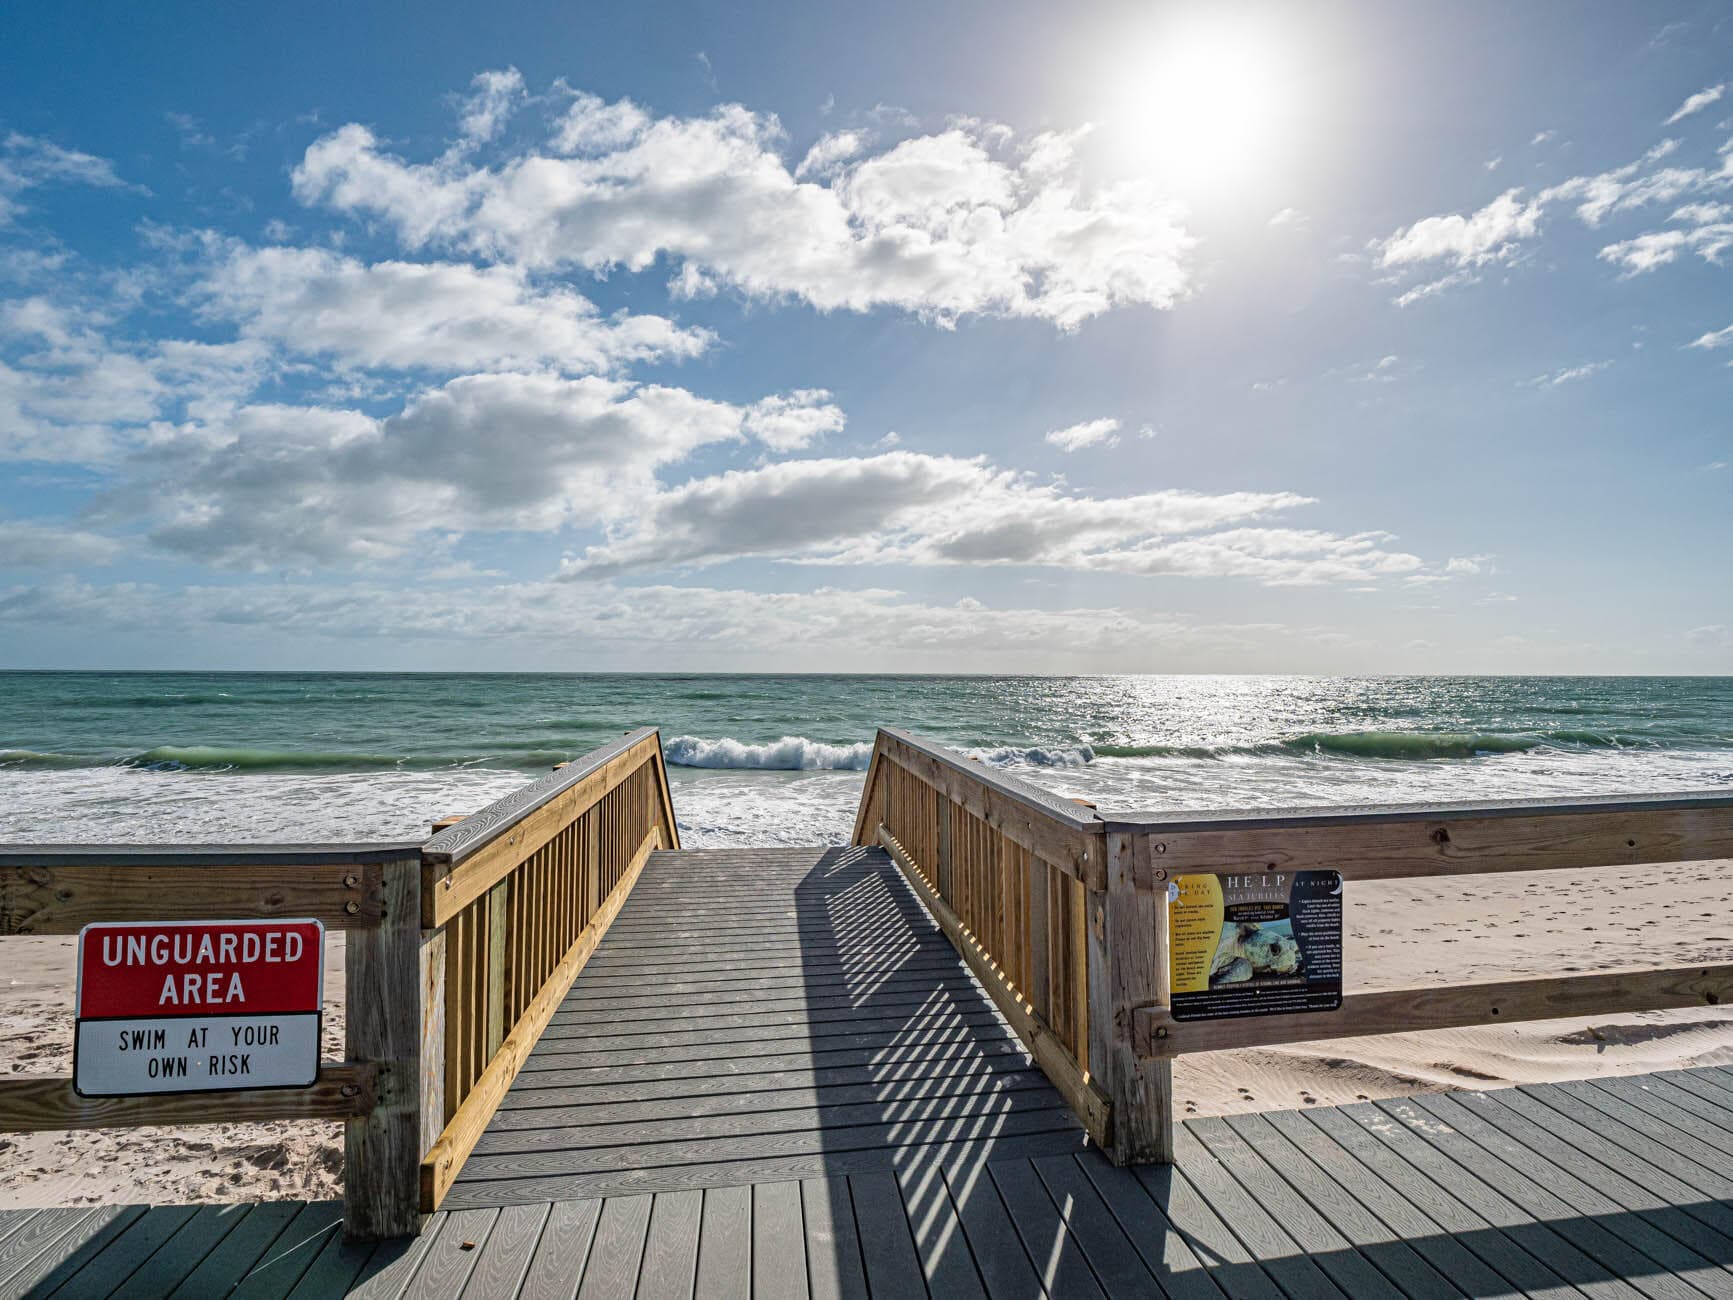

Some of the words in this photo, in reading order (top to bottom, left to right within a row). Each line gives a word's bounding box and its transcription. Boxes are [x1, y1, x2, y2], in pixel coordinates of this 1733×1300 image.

[1227, 874, 1285, 889] HELP
[102, 932, 303, 967] UNGUARDED
[158, 972, 246, 1005] AREA
[118, 1029, 166, 1051] SWIM
[187, 1027, 209, 1048] AT
[231, 1025, 279, 1046] YOUR
[147, 1056, 188, 1078] OWN
[208, 1054, 250, 1076] RISK
